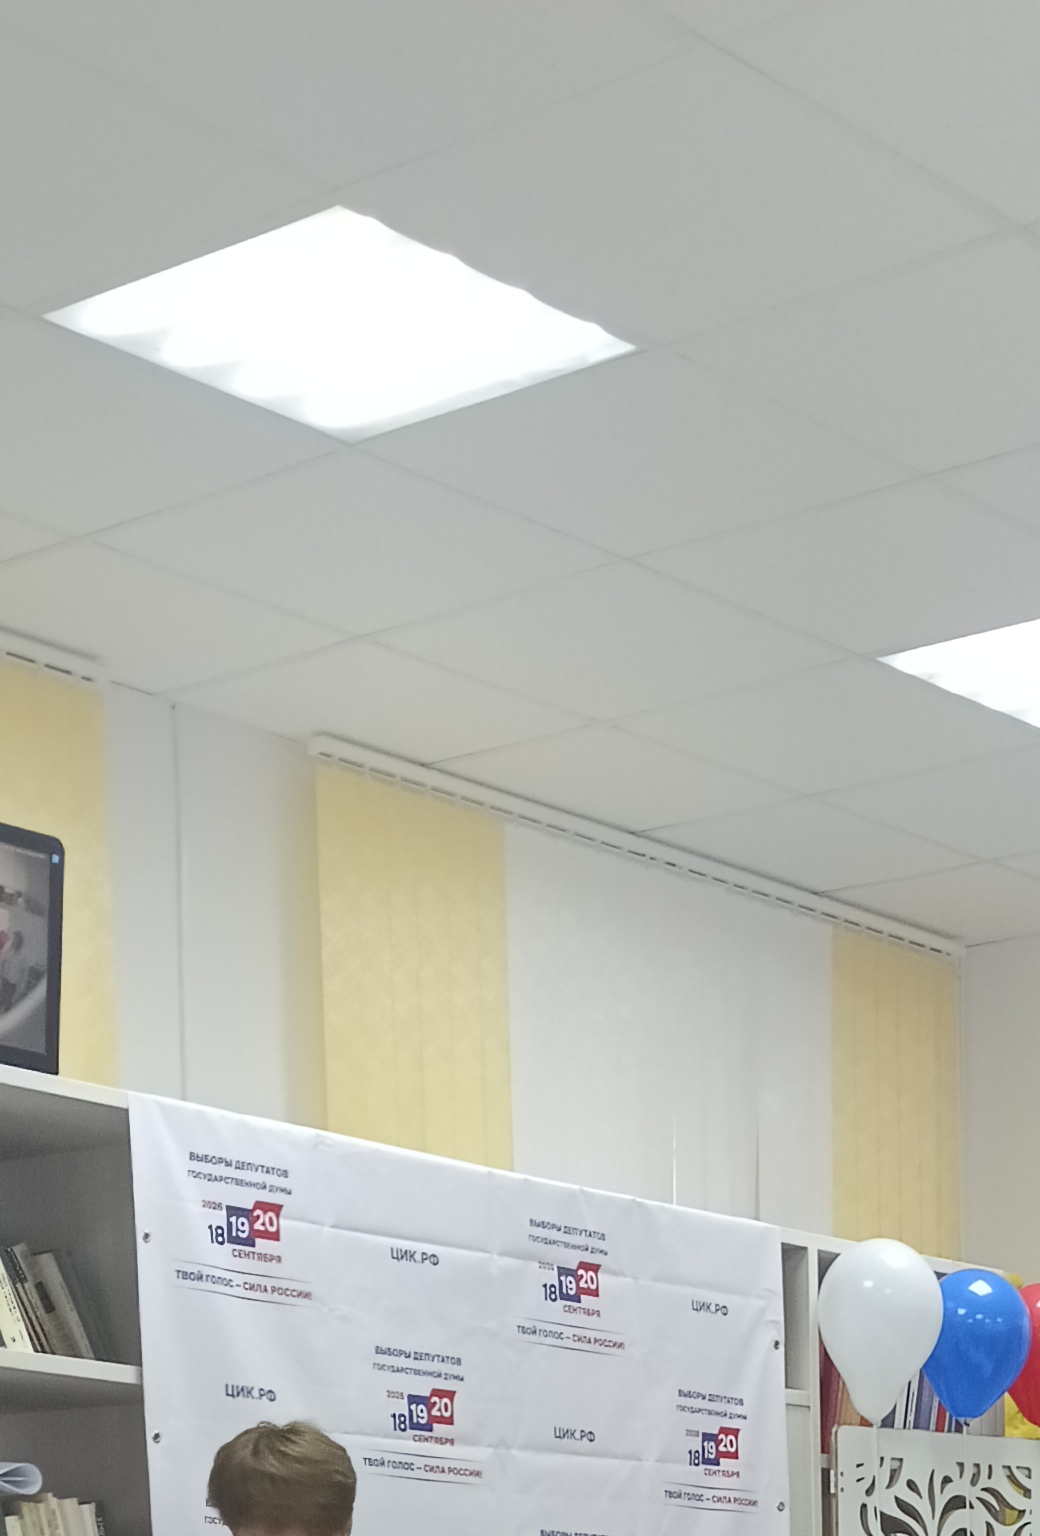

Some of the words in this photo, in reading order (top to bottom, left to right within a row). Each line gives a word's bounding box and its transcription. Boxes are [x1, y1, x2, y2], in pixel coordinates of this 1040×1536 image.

[189, 1152, 232, 1167] ВЫБОРЫ
[234, 1160, 289, 1178] ДЕПУТАТОВ
[268, 1186, 292, 1195] ДУМЫ
[207, 1224, 226, 1245] 18
[229, 1216, 250, 1238] 19
[253, 1210, 277, 1232] 20
[529, 1218, 561, 1232] ВЫБОРЫ
[563, 1225, 606, 1241] ДЕПУТАТОВ
[232, 1249, 282, 1263] СЕНТЯБРЯ
[390, 1247, 440, 1266] ЦИК.РФ
[590, 1246, 608, 1256] ДУМЫ
[175, 1269, 203, 1281] ТВОЙ
[205, 1275, 234, 1288] ГОЛОС
[243, 1282, 268, 1293] СИЛА
[542, 1283, 558, 1302] 18
[559, 1275, 576, 1295] 19
[577, 1269, 597, 1290] 20
[563, 1304, 601, 1318] СЕНТЯБРЯ
[691, 1299, 729, 1316] ЦИК.РФ
[517, 1325, 537, 1336] ТВОЙ
[538, 1329, 564, 1341] ГОЛОС
[572, 1334, 592, 1345] СИЛА
[375, 1345, 411, 1359] ВЫБОРЫ
[413, 1351, 462, 1366] ДЕПУТАТОВ
[443, 1372, 464, 1382] ДУМЫ
[225, 1384, 276, 1402] ЦИК.РФ
[391, 1412, 407, 1432] 18
[410, 1403, 428, 1424] 19
[430, 1396, 451, 1418] 20
[412, 1434, 455, 1446] СЕНТЯБРЯ
[553, 1426, 596, 1443] ЦИК.РФ
[688, 1449, 700, 1467] 18
[703, 1440, 716, 1459] 19
[718, 1434, 736, 1453] 20
[363, 1457, 385, 1467] ТВОЙ
[387, 1460, 415, 1471] ГОЛОС
[423, 1464, 446, 1474] СИЛА
